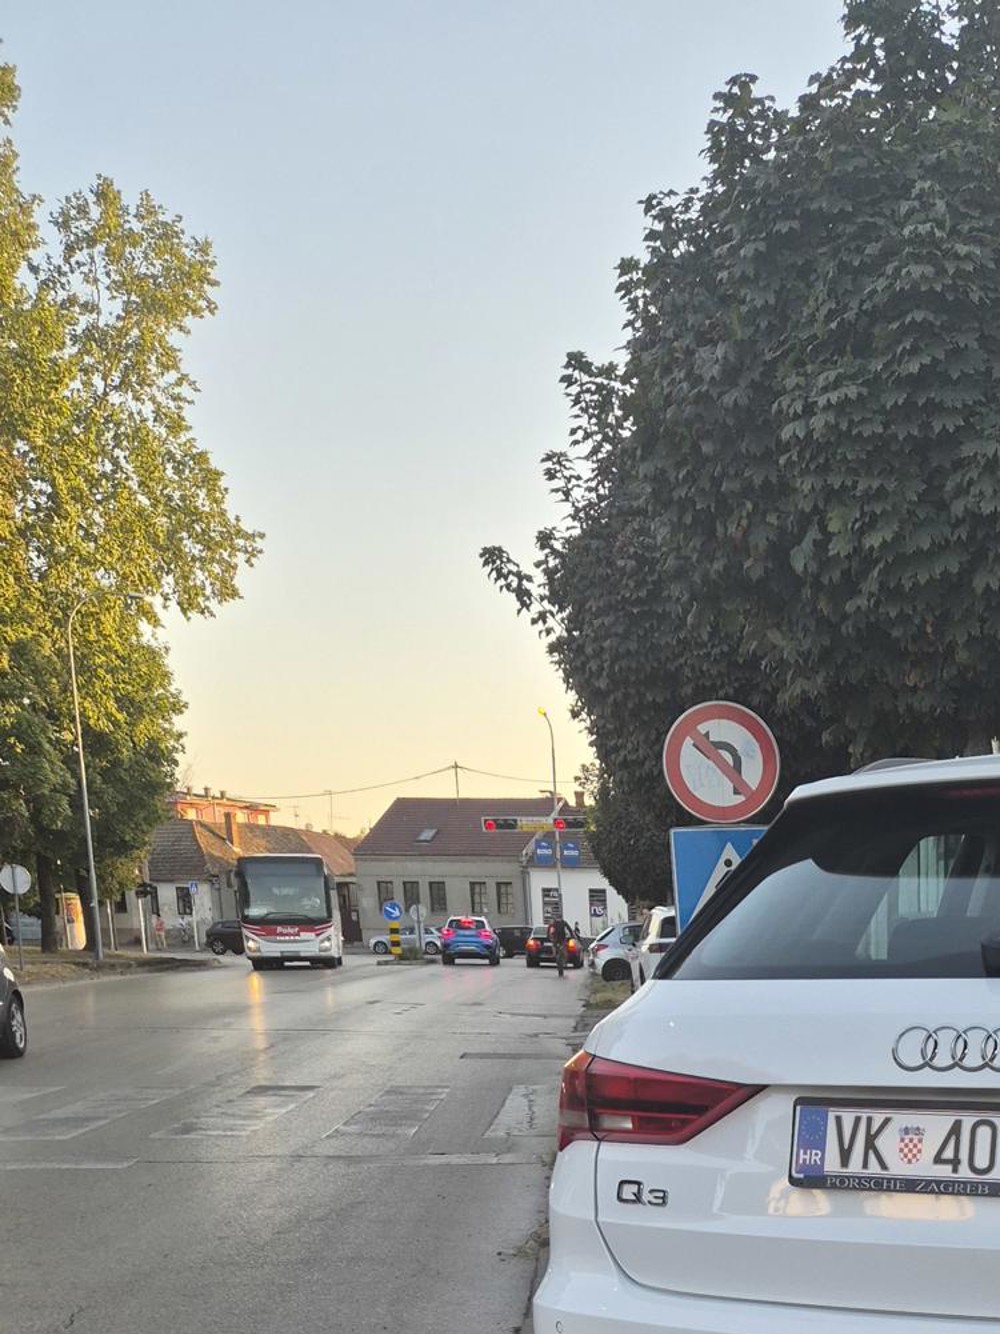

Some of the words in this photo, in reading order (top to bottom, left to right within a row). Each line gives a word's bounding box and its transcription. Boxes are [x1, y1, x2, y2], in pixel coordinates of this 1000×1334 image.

[835, 1115, 893, 1171] VK
[799, 1148, 822, 1166] HR
[617, 1180, 668, 1207] Q3
[826, 1176, 906, 1191] PORSCHE
[915, 1181, 989, 1194] ZAGREB
